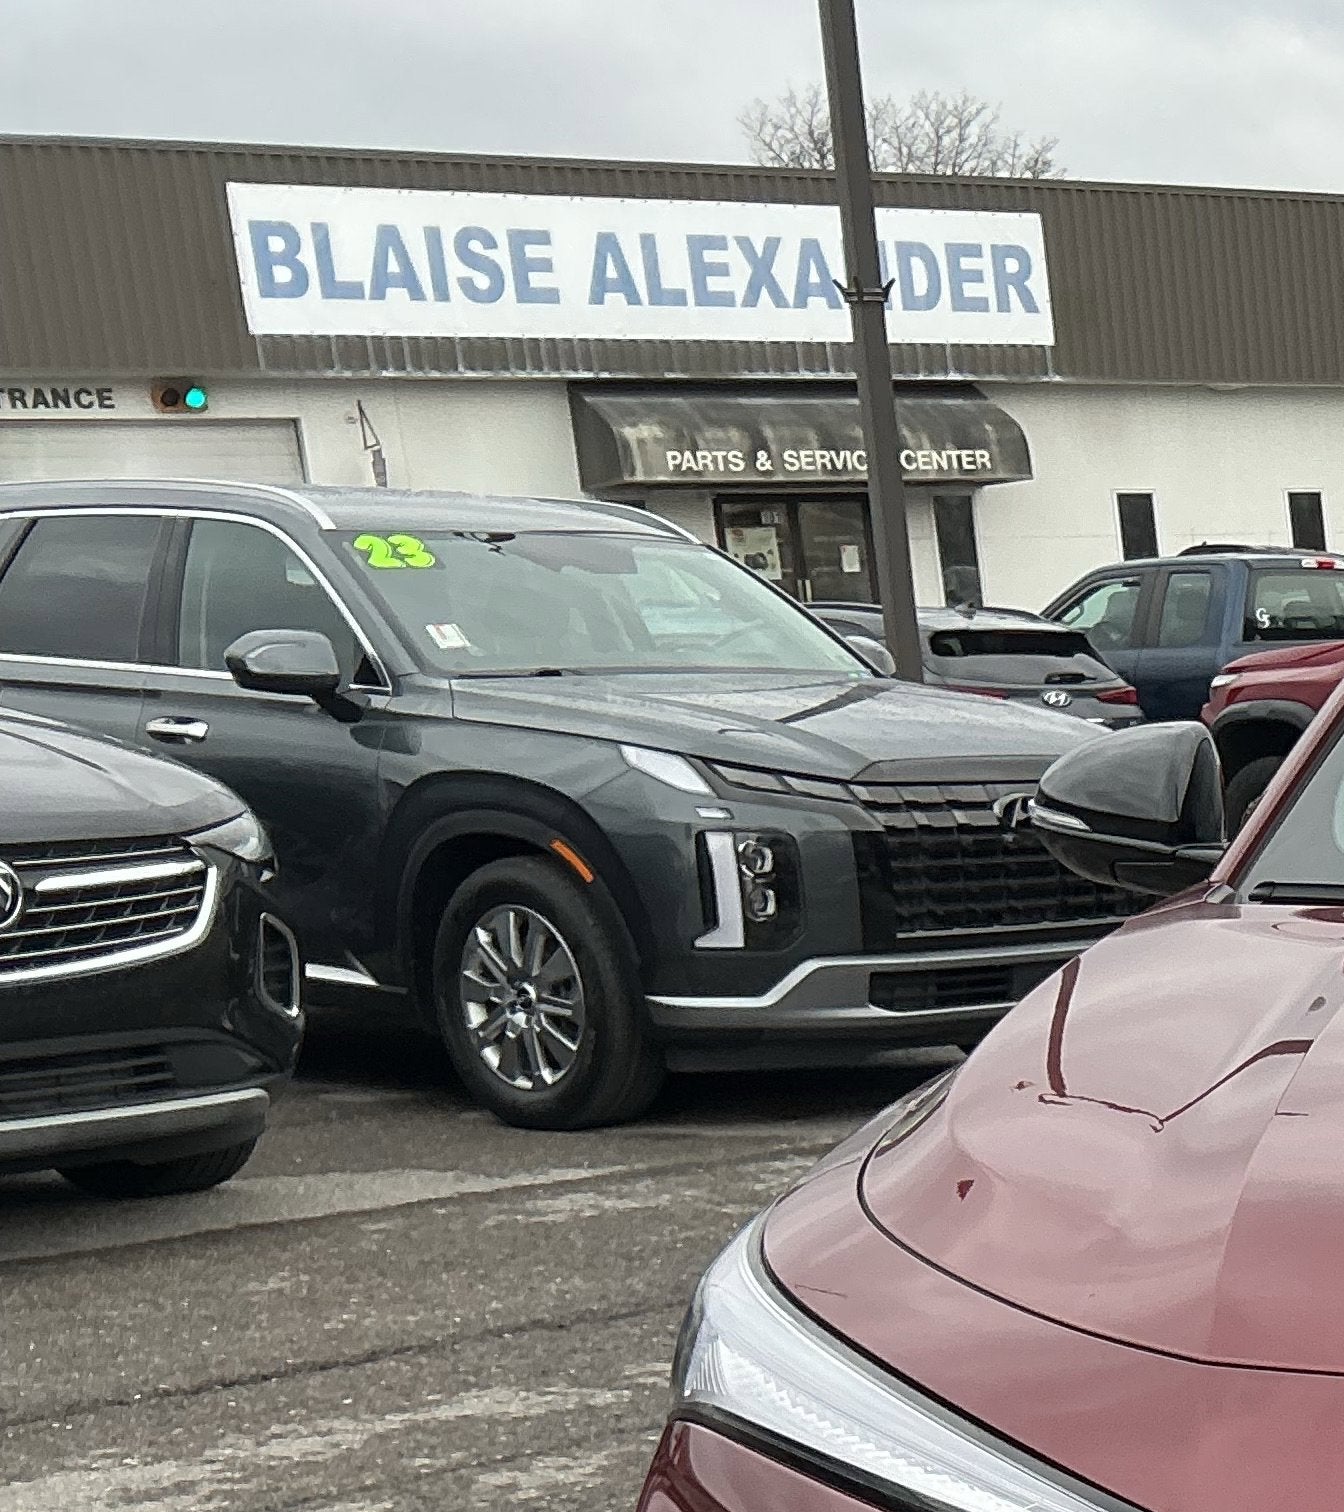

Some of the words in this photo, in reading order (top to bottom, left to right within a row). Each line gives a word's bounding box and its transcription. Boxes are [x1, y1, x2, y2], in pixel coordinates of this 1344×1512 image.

[247, 219, 561, 305] BLAISE
[588, 231, 1041, 315] ALEXADER
[0, 387, 115, 409] RANCE
[666, 449, 745, 472] PARTS
[755, 449, 773, 472] &
[783, 449, 869, 472] SERVIC
[899, 449, 992, 470] CENTER
[353, 533, 436, 568] 23
